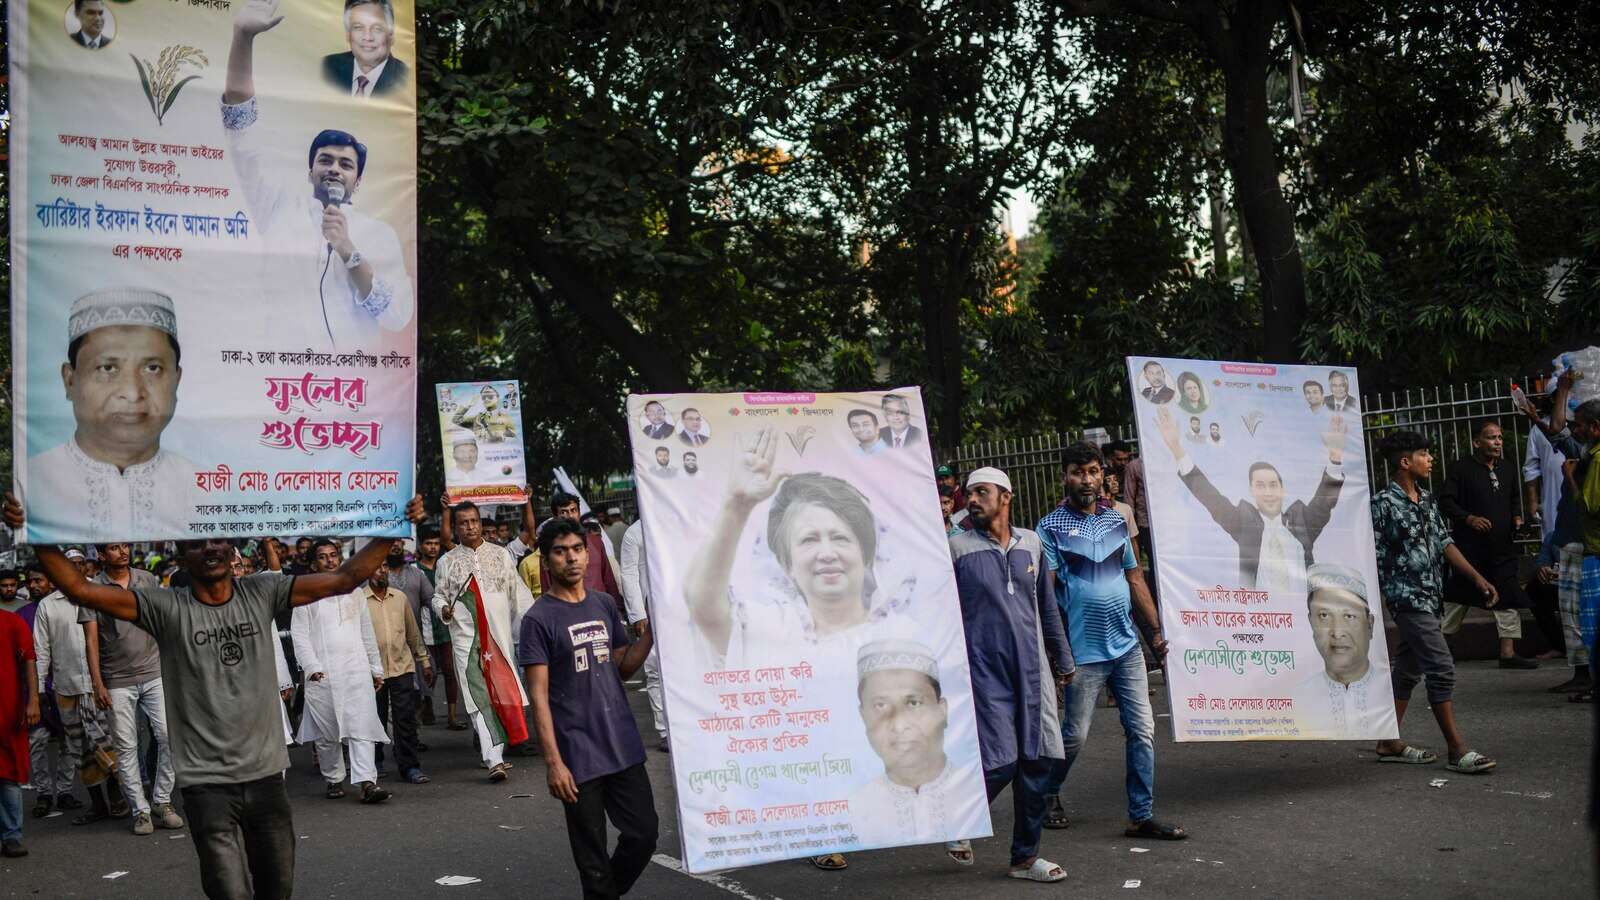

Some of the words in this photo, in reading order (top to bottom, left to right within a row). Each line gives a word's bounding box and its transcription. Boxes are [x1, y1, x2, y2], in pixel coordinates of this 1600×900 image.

[101, 137, 129, 150] আমান
[132, 139, 157, 155] উল্লাহ
[160, 143, 187, 157] আমান
[191, 144, 224, 160] ভাইয়ের
[103, 158, 135, 173] সুযোগ্য
[50, 174, 72, 188] ঢাকা
[76, 176, 99, 190] জেলা
[103, 175, 143, 192] বিএনপির
[146, 179, 190, 194] সাংগঠনিক
[193, 187, 231, 199] সম্পাদক
[36, 197, 91, 229] ব্যারিষ্টার
[95, 201, 140, 233] ইরফান
[144, 204, 178, 236] ইবনে
[182, 213, 220, 239] আমান
[224, 211, 249, 240] অমি
[112, 243, 129, 260] এর
[134, 245, 183, 262] পক্ষথেকে
[221, 350, 253, 366] ঢাকা-২
[257, 351, 275, 366] তথা
[380, 350, 411, 369] বাসীকে
[264, 372, 369, 413] ফুলের
[257, 416, 383, 460] শুভেচ্ছা
[194, 463, 233, 493] হাজী
[238, 471, 268, 492] মোঃ
[274, 471, 342, 492] দেলোয়ার
[348, 471, 399, 491] হোসেন
[195, 504, 222, 516] সাবেক
[225, 501, 274, 515] সহ-সভাপতি
[282, 503, 300, 514] ঢাকা
[303, 503, 334, 513] মহানগর
[336, 500, 365, 514] বিএনপি
[189, 521, 216, 533] সাবেক
[257, 521, 263, 530] ও
[266, 518, 298, 532] সভাপতি
[1197, 585, 1230, 603] আগামীর
[1180, 610, 1209, 627] জনাব
[1212, 611, 1246, 628] তারেক
[1249, 612, 1293, 629] রহমানের
[194, 622, 259, 646] CHANEL
[1184, 639, 1247, 675] দেশবাসীকে
[1250, 649, 1297, 675] শুভেচ্ছা
[704, 669, 750, 686] প্রাণভরে
[755, 667, 785, 683] দোয়া
[789, 661, 813, 680] করি
[742, 690, 766, 706] হয়ে
[1188, 693, 1206, 711] হাজী
[1210, 699, 1226, 710] মোঃ
[1229, 699, 1264, 711] দেলোয়ার
[1266, 698, 1293, 710] হোসেন
[698, 712, 744, 733] আঠারো
[750, 708, 782, 729] কোটি
[785, 708, 830, 728] মানুষের
[688, 759, 742, 794] দেশনেত্রী
[745, 764, 777, 791] বেগম
[781, 760, 822, 786] খালেদা
[823, 752, 852, 776] জিয়া
[703, 805, 732, 828] হাজী
[736, 808, 758, 825] মোঃ
[761, 803, 809, 822] দেলোয়ার
[813, 799, 849, 817] হোসেন
